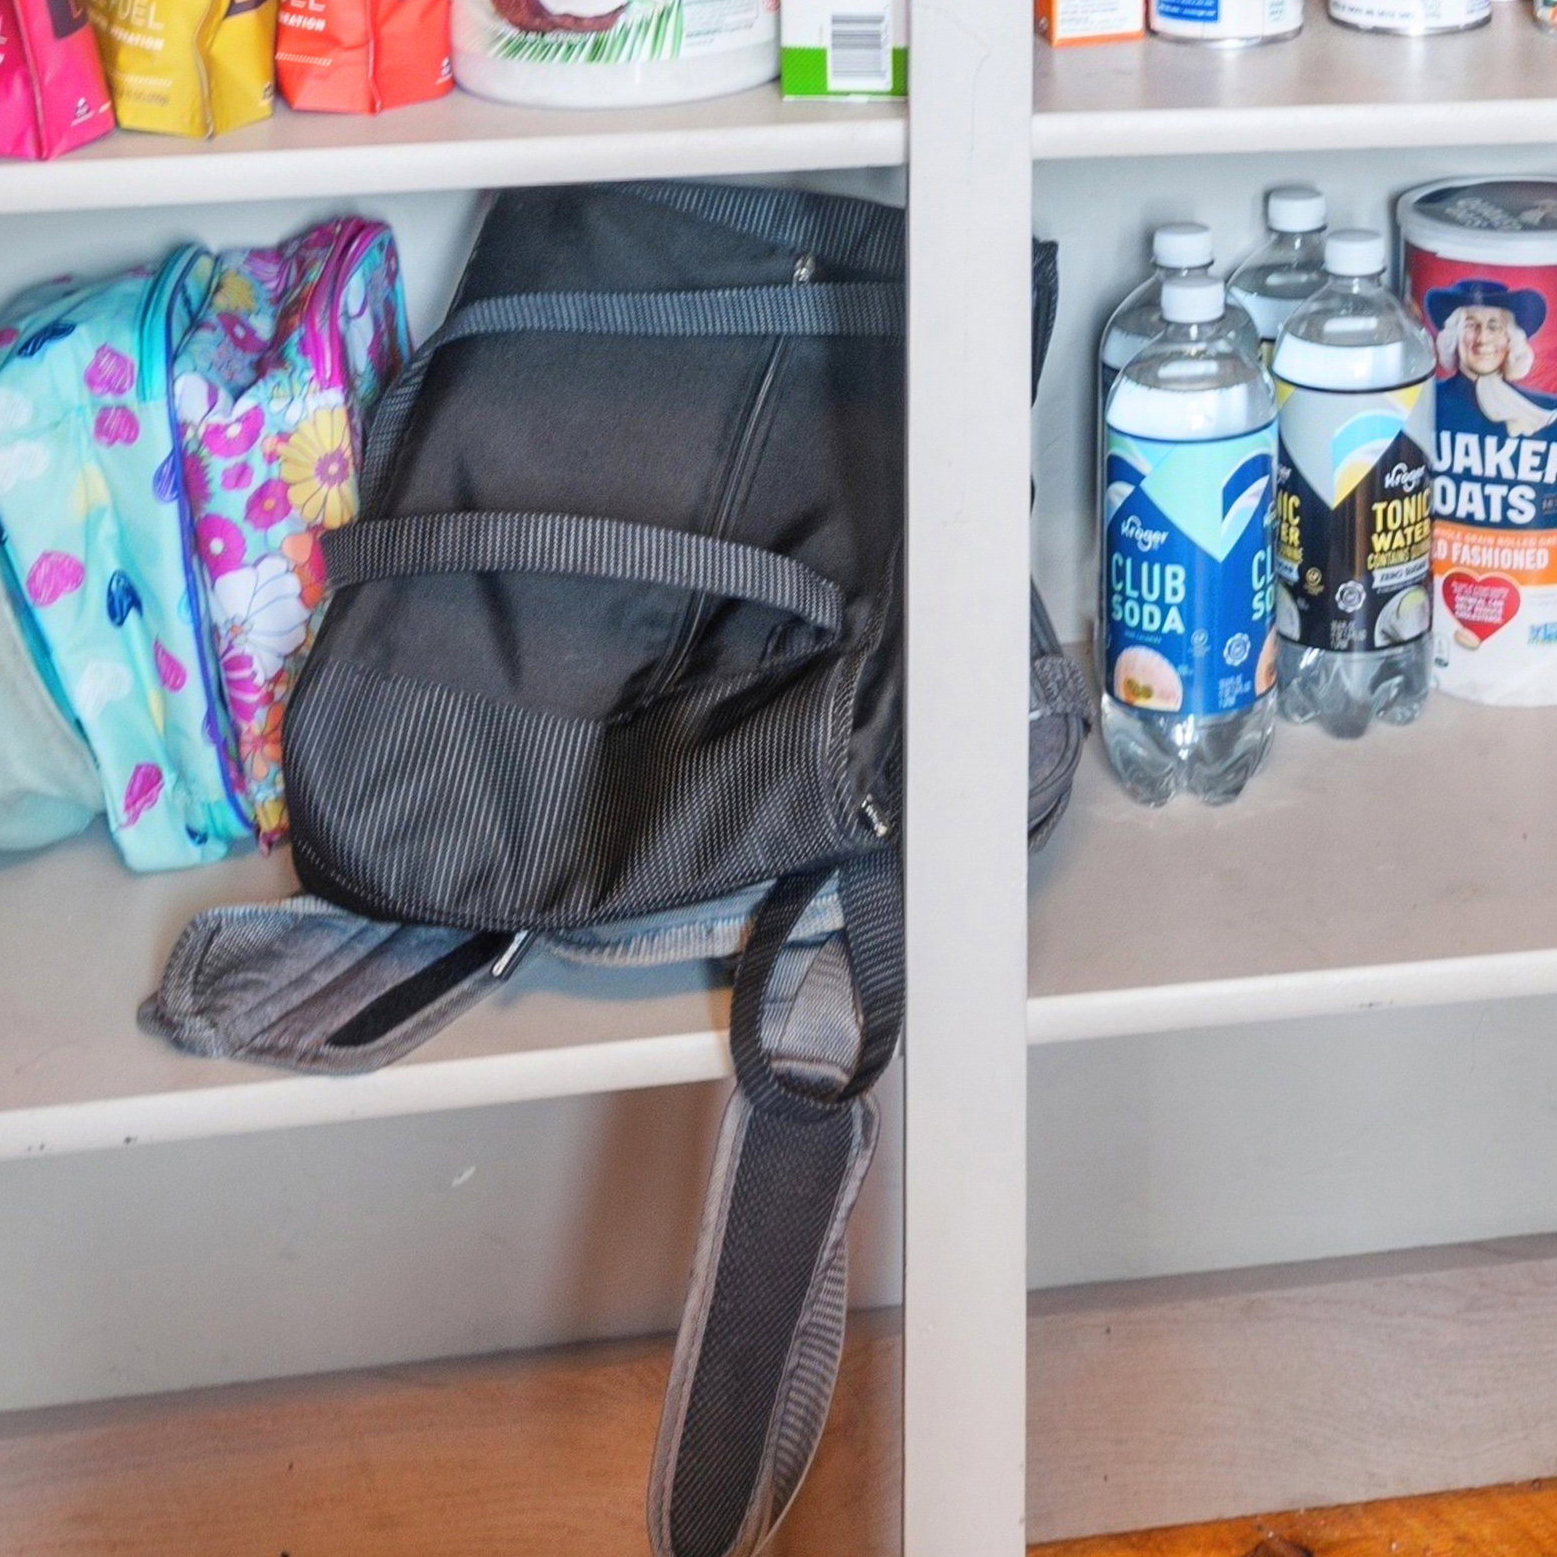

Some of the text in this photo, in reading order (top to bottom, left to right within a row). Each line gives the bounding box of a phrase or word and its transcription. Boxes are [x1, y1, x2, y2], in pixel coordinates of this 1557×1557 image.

[1384, 465, 1426, 492] Kroger
[1372, 488, 1431, 533] TONIC
[1433, 478, 1536, 523] OATS
[1121, 513, 1169, 552] Kroger
[1372, 519, 1431, 552] WATER
[1380, 561, 1427, 582] ZERO SUGAR
[1452, 545, 1548, 570] FASHIONED
[1111, 551, 1187, 605] CLUB
[1111, 594, 1186, 635] SODA
